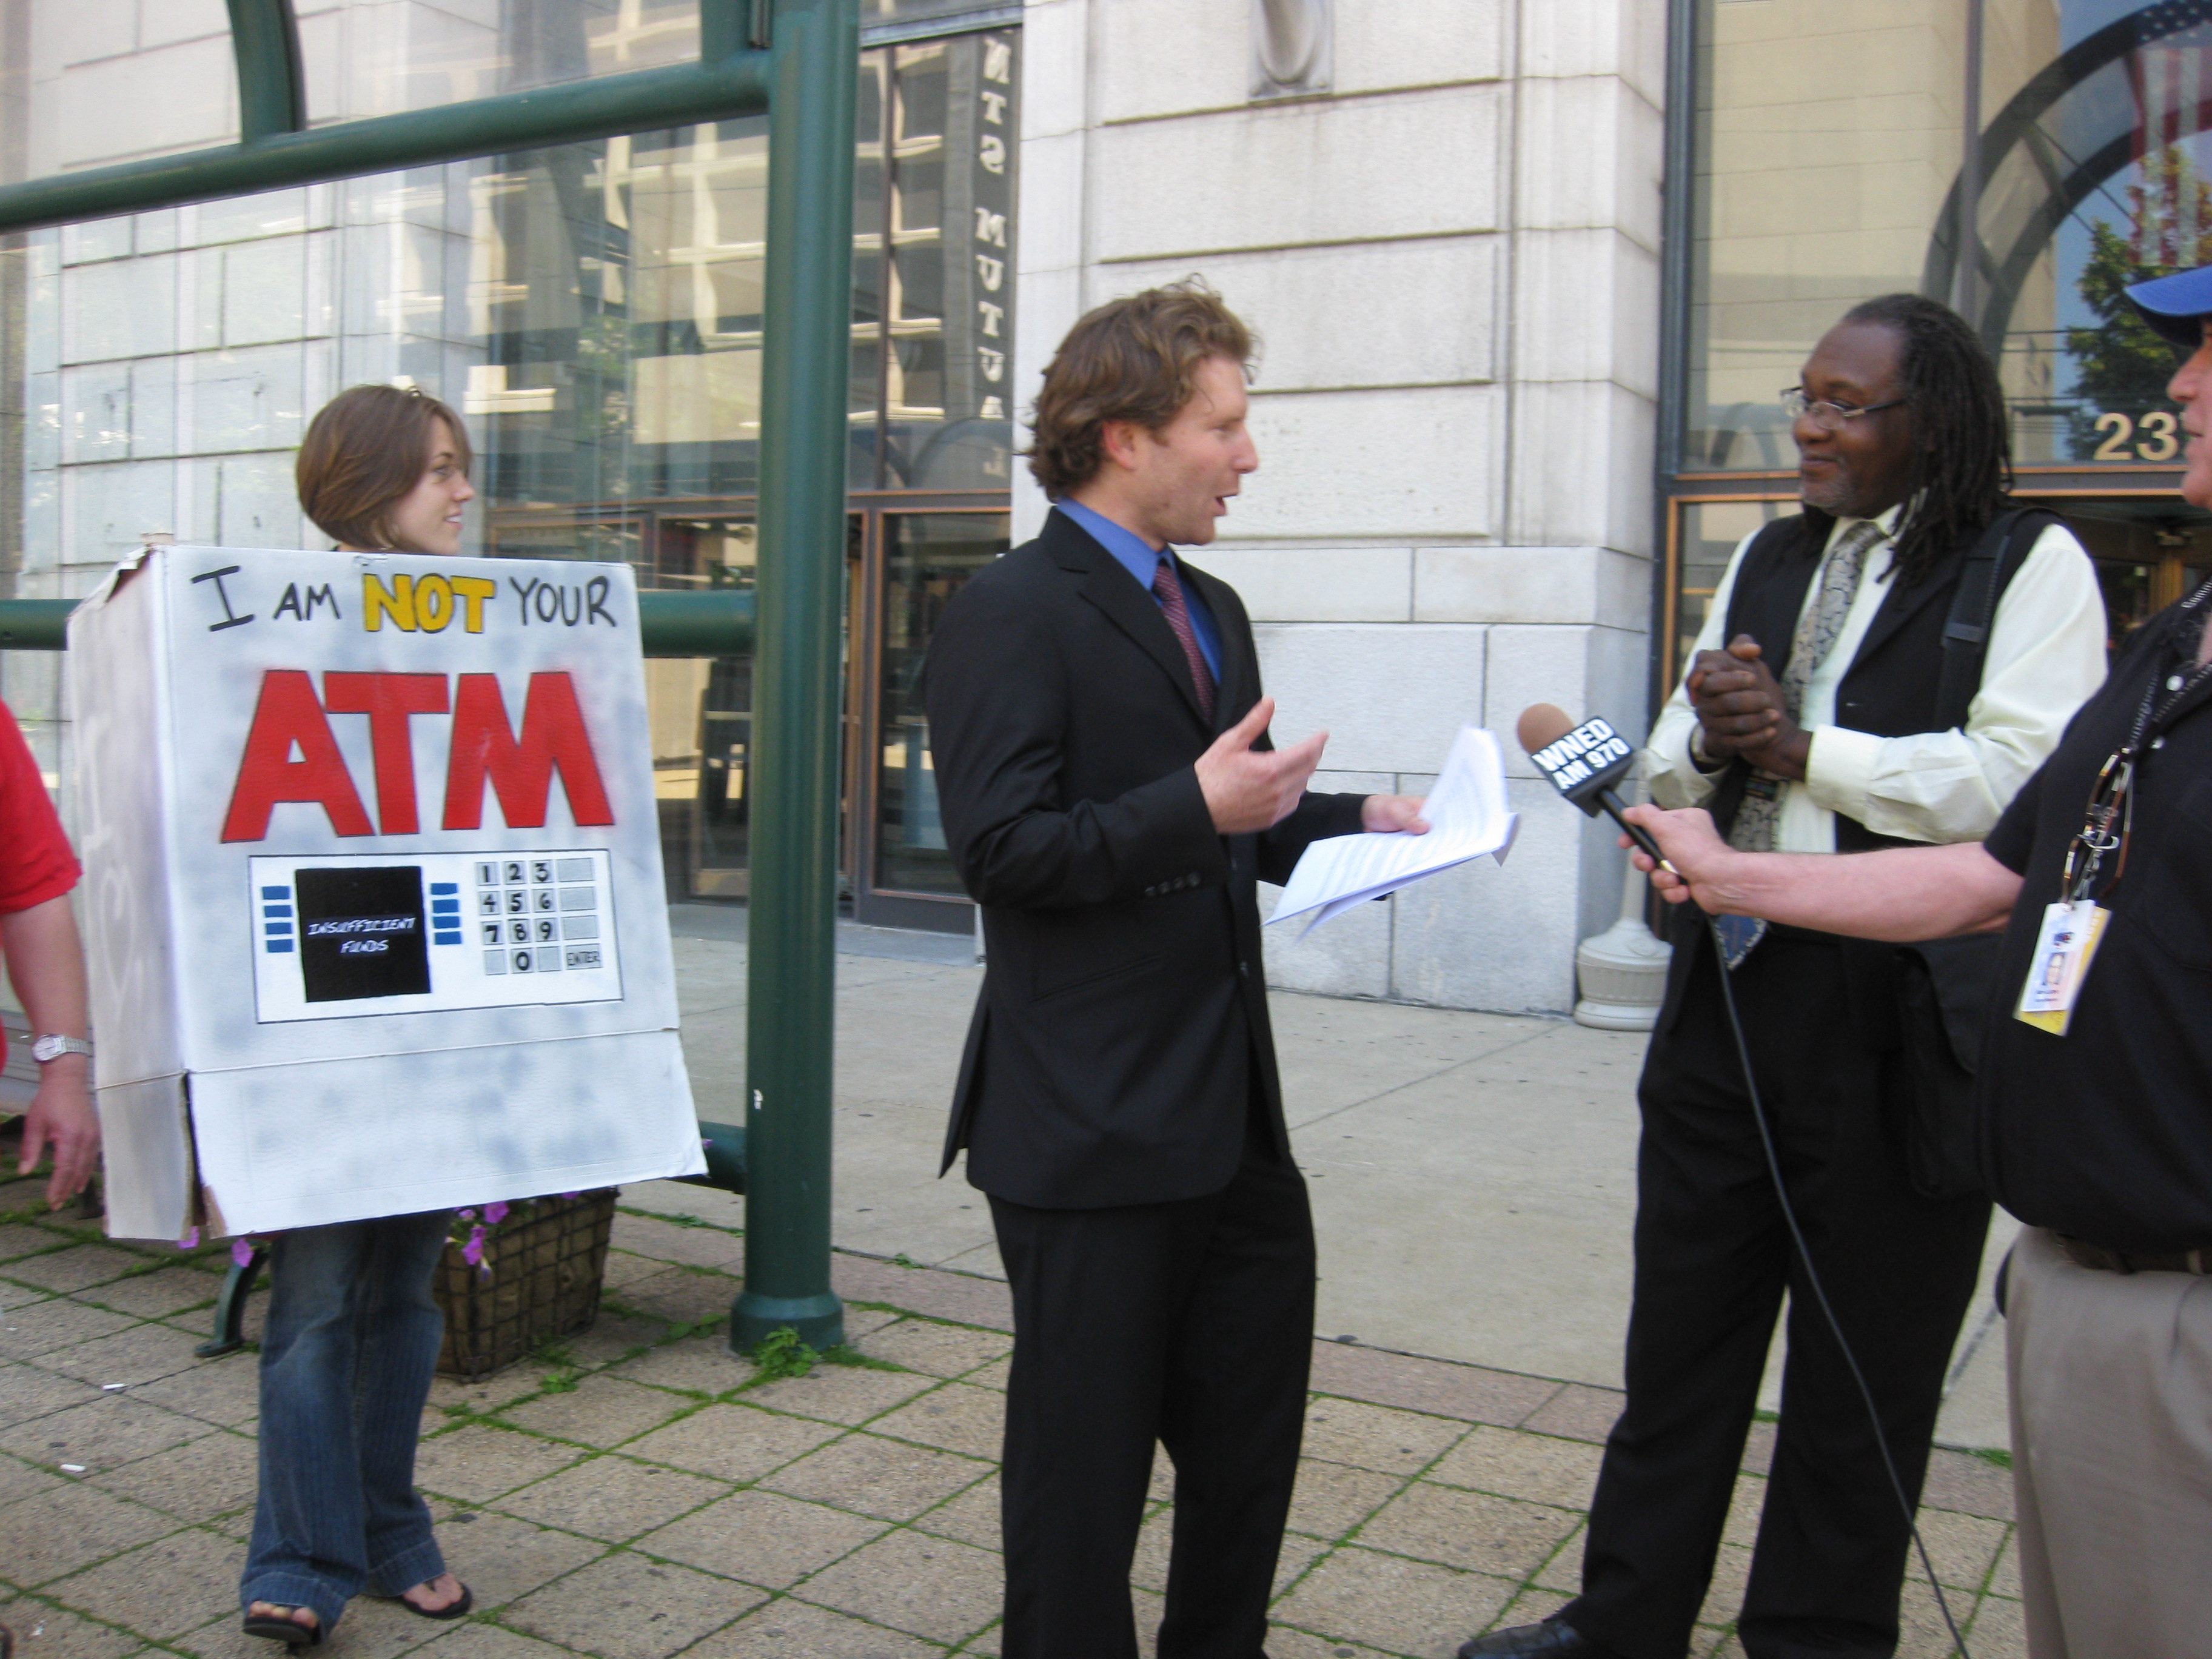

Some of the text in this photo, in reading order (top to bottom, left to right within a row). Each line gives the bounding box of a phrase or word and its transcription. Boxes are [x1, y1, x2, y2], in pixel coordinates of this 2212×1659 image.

[2093, 411, 2185, 461] 23
[190, 565, 618, 634] I AM NOT YOUR
[1531, 718, 1615, 772] WNED
[220, 669, 615, 843] ATM
[1552, 737, 1632, 789] AM 970
[483, 862, 549, 882] 1 2 3
[483, 893, 551, 913] 4 5 6
[308, 916, 417, 936] INSUFFICIENT
[485, 921, 551, 942] 7 8 9
[340, 939, 389, 954] FUNDS
[517, 951, 600, 971] 0 ENTER
